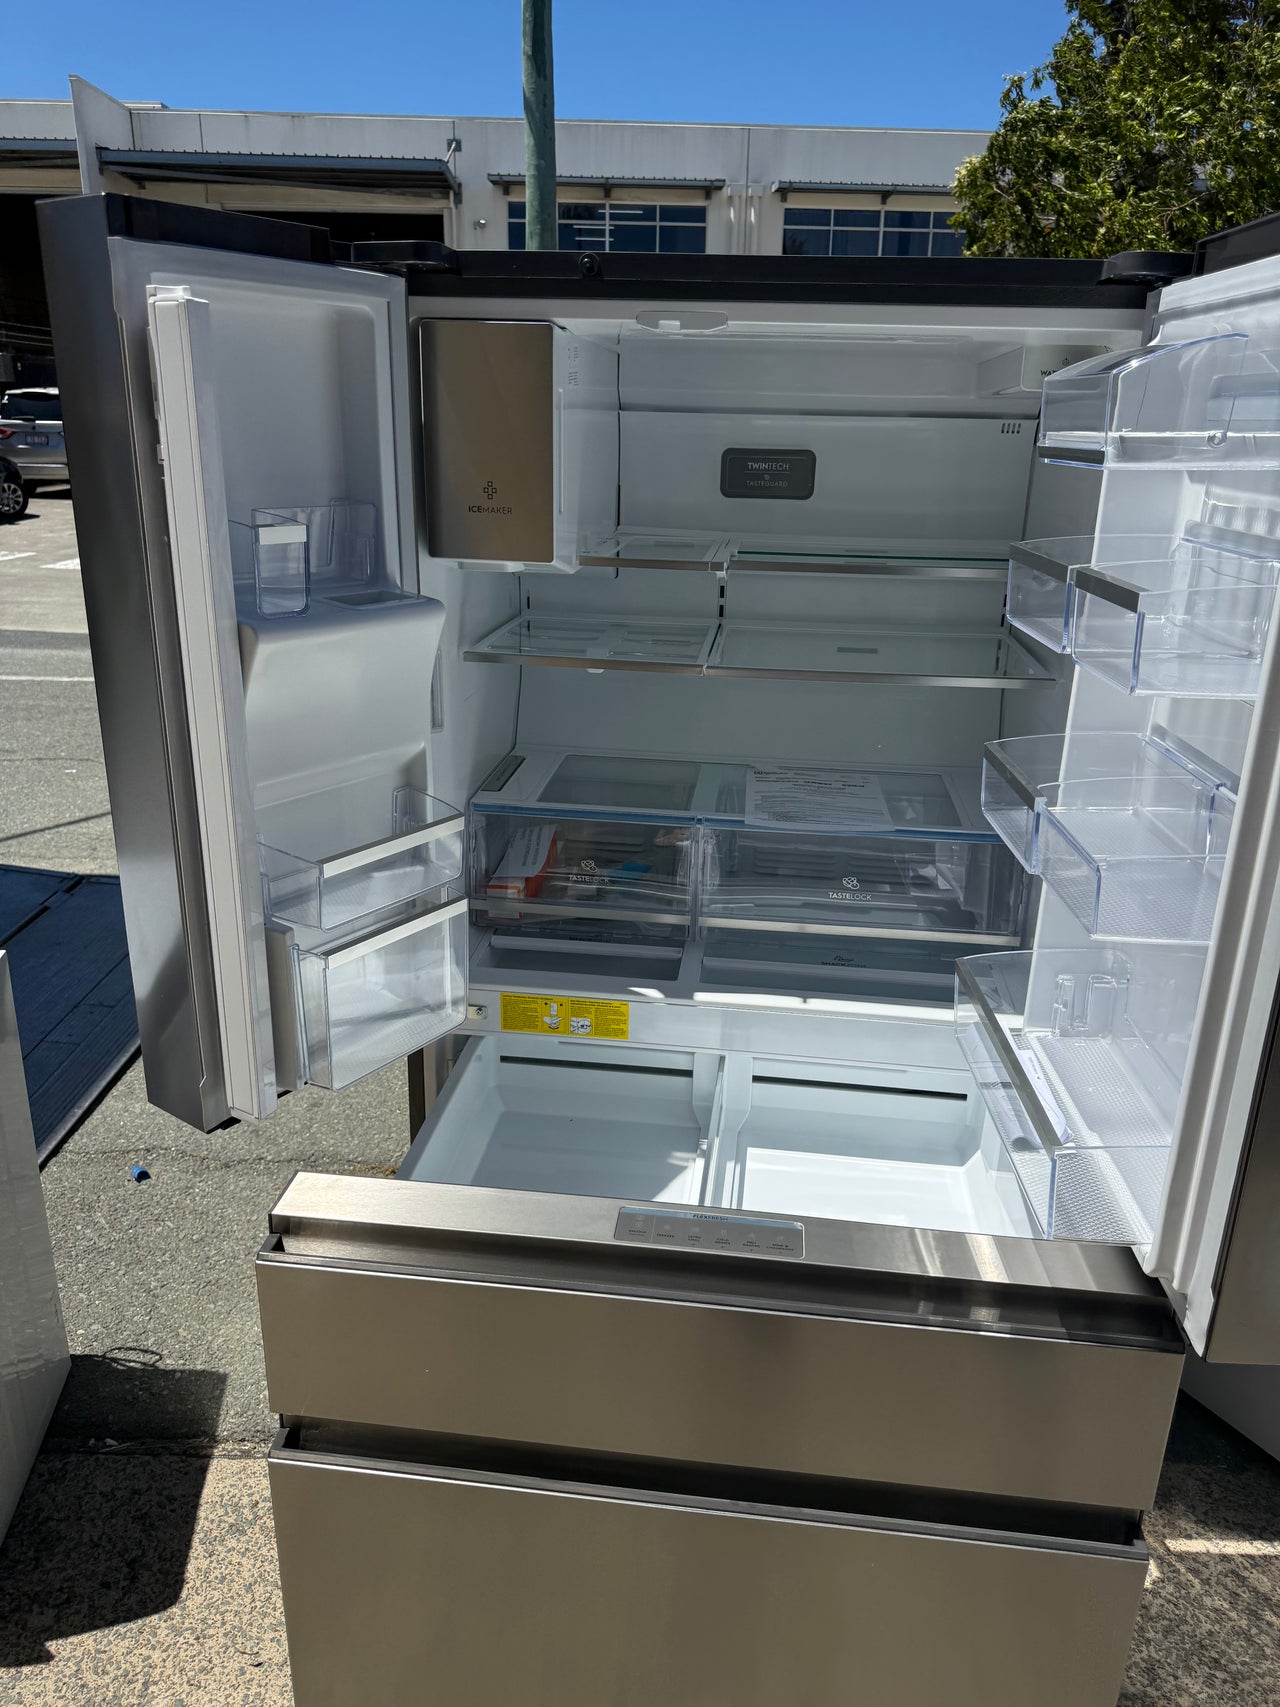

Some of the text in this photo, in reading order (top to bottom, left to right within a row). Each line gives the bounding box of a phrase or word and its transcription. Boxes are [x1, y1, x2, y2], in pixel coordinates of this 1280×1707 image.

[747, 462, 790, 471] TWINTECH
[468, 505, 513, 515] ICEMAKER
[568, 874, 610, 883] TASTELOCK
[828, 891, 872, 901] TASTELOCK
